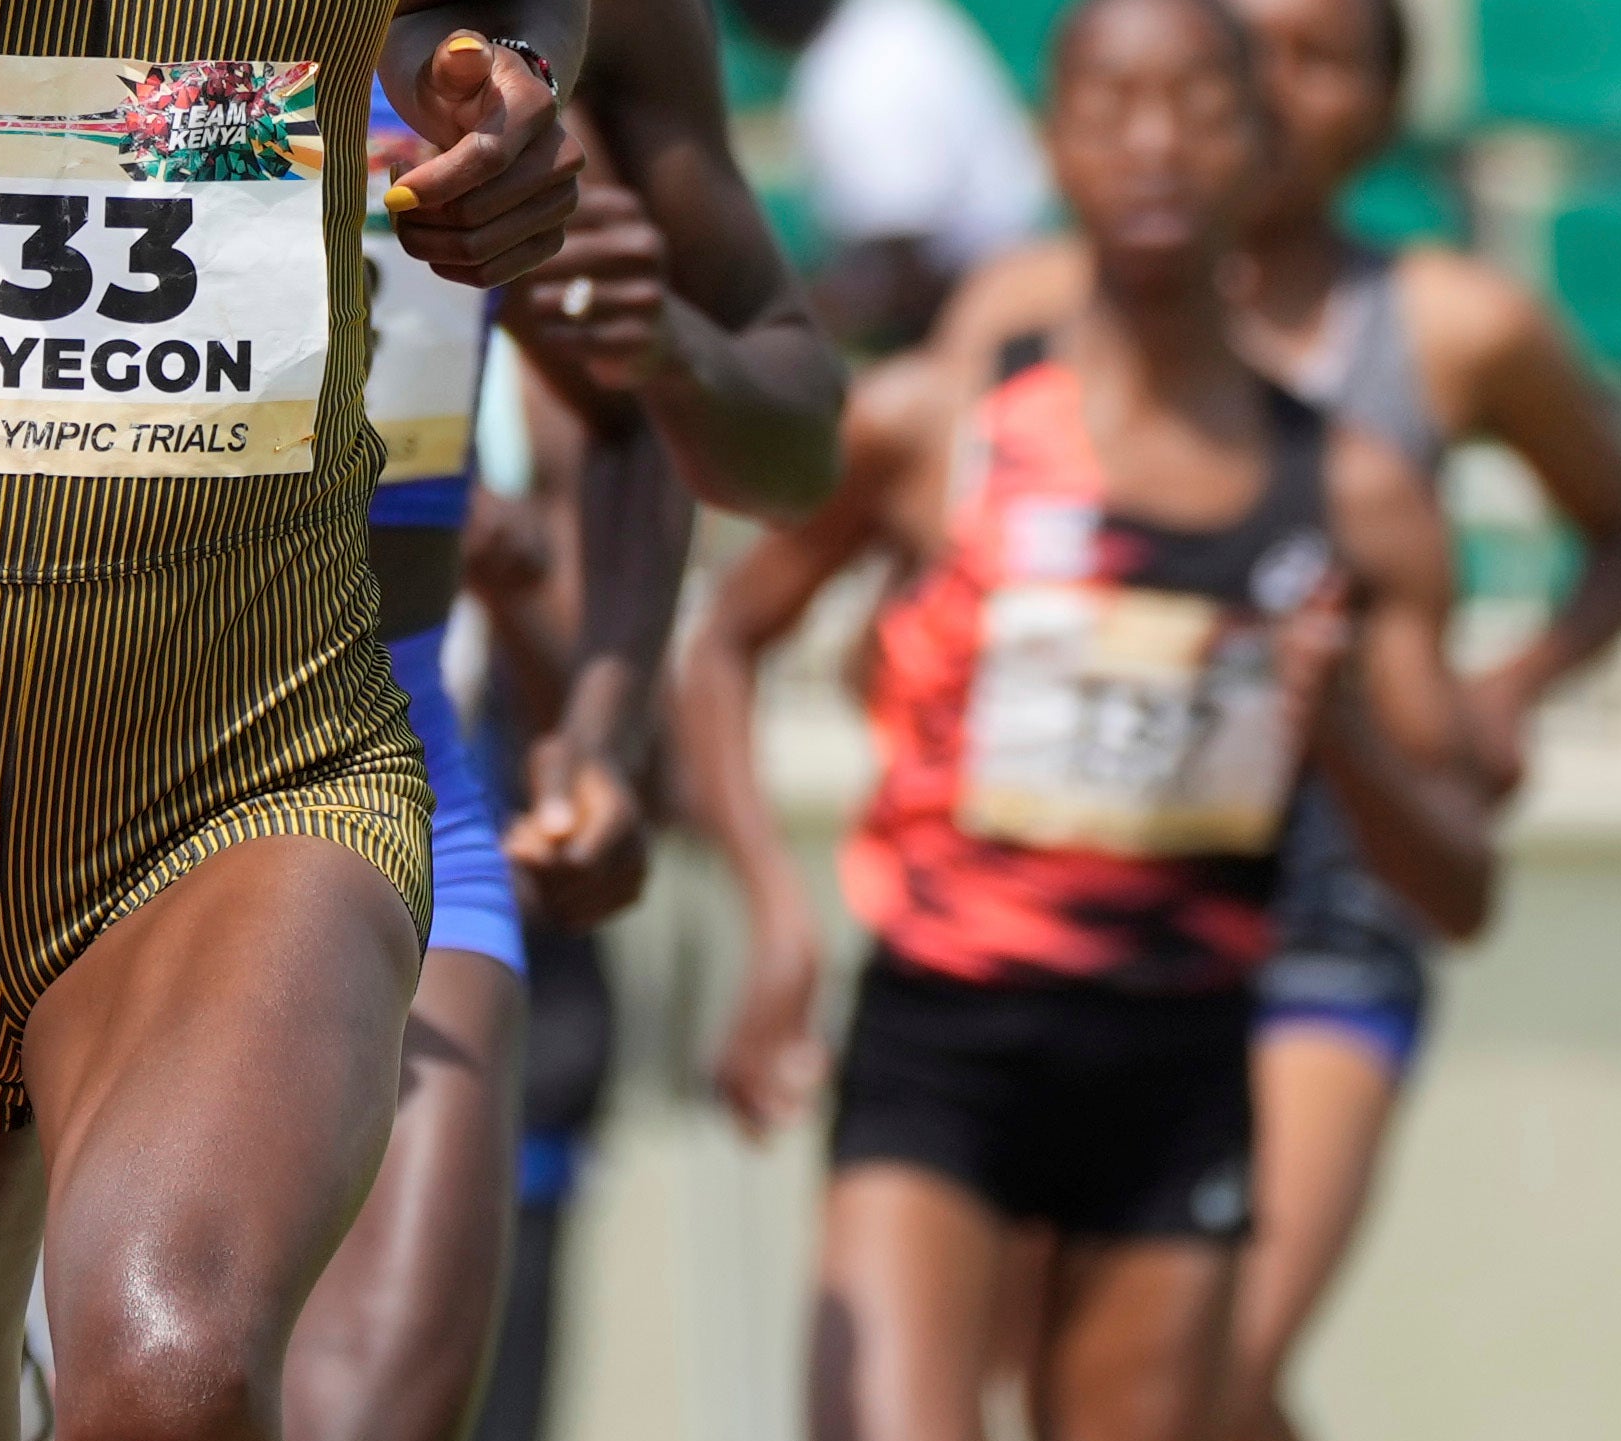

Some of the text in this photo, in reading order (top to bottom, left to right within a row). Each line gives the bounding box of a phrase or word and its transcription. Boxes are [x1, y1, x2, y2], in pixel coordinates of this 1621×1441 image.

[169, 101, 247, 129] TEAM
[168, 126, 247, 151] KENYA
[129, 422, 250, 453] TRIALS
